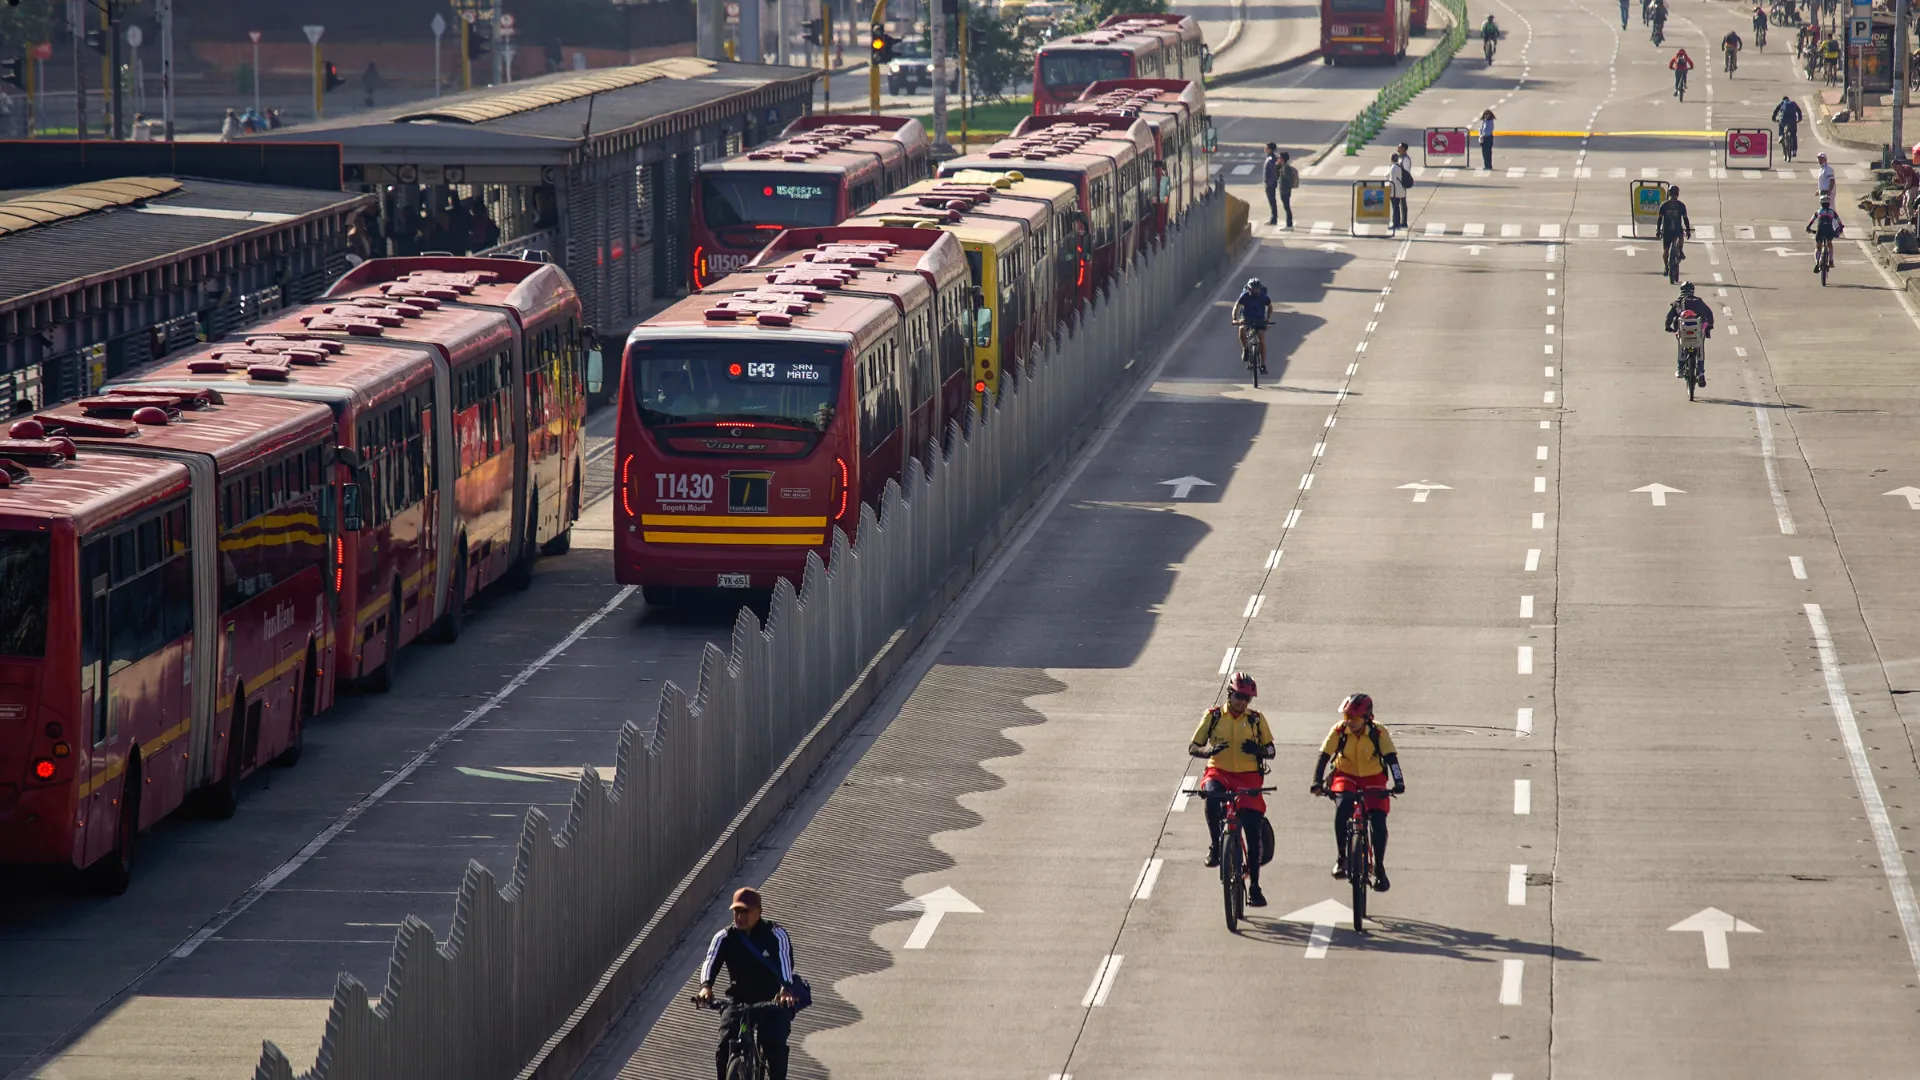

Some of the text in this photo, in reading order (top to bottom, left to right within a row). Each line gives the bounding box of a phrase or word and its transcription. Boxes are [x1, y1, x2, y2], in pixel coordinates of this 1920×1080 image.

[1856, 22, 1866, 36] P
[748, 362, 775, 377] G43
[786, 371, 819, 379] MATEO
[706, 440, 744, 449] Viale
[655, 473, 714, 498] T1430
[662, 503, 685, 512] Bogotá
